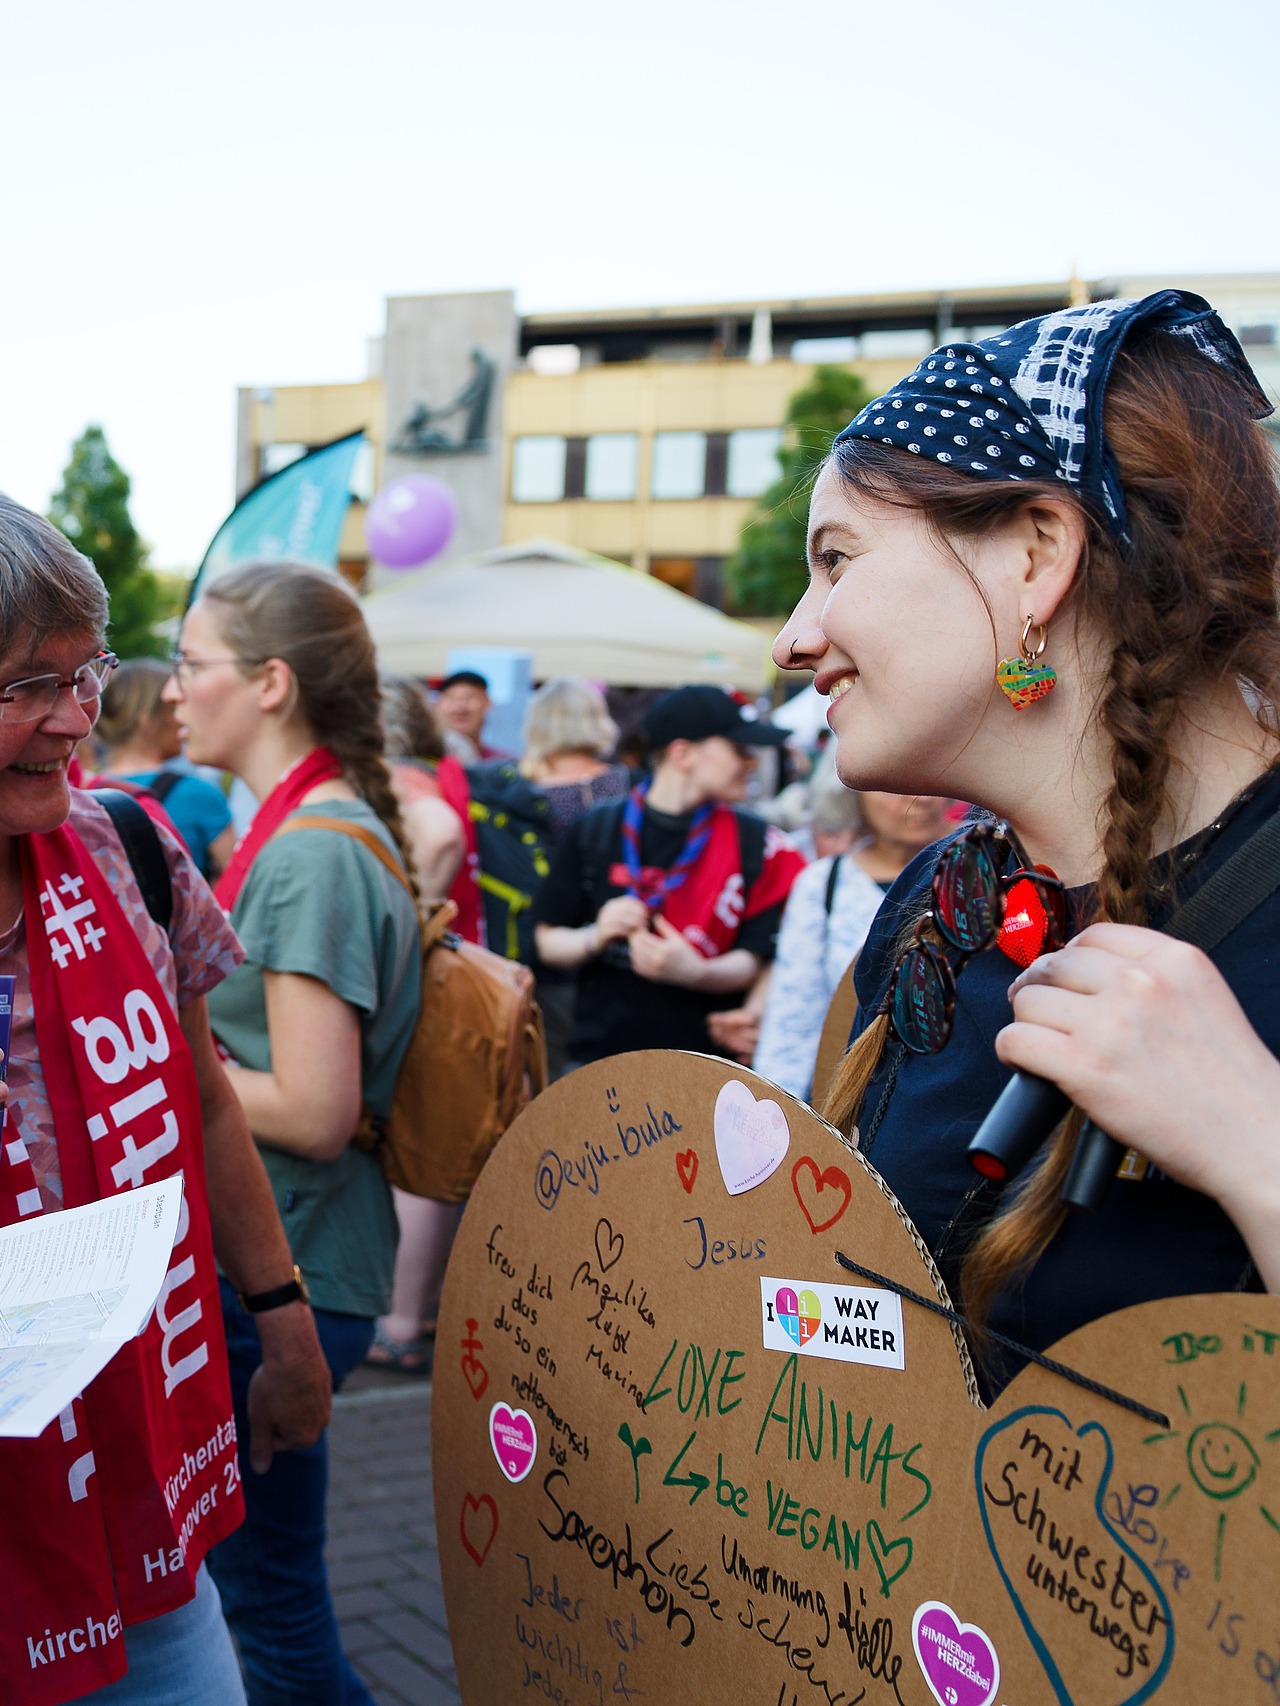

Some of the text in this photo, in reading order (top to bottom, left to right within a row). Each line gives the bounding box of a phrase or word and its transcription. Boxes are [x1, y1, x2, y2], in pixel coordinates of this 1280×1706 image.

[71, 988, 209, 1399] mtig
[486, 1224, 553, 1301] freu dich
[682, 1217, 768, 1270] Jesus
[766, 1302, 775, 1322] I
[833, 1296, 880, 1321] WAY
[823, 1322, 897, 1352] MAKER
[536, 1346, 557, 1377] ein
[1019, 1428, 1083, 1491] mit
[716, 1453, 861, 1571] be VEGAN
[984, 1461, 1170, 1636] Schwester
[27, 1607, 123, 1669] kirche
[920, 1624, 976, 1667] #IMMERmit
[1026, 1554, 1150, 1678] unterwegs
[937, 1646, 990, 1692] HERZdabei
